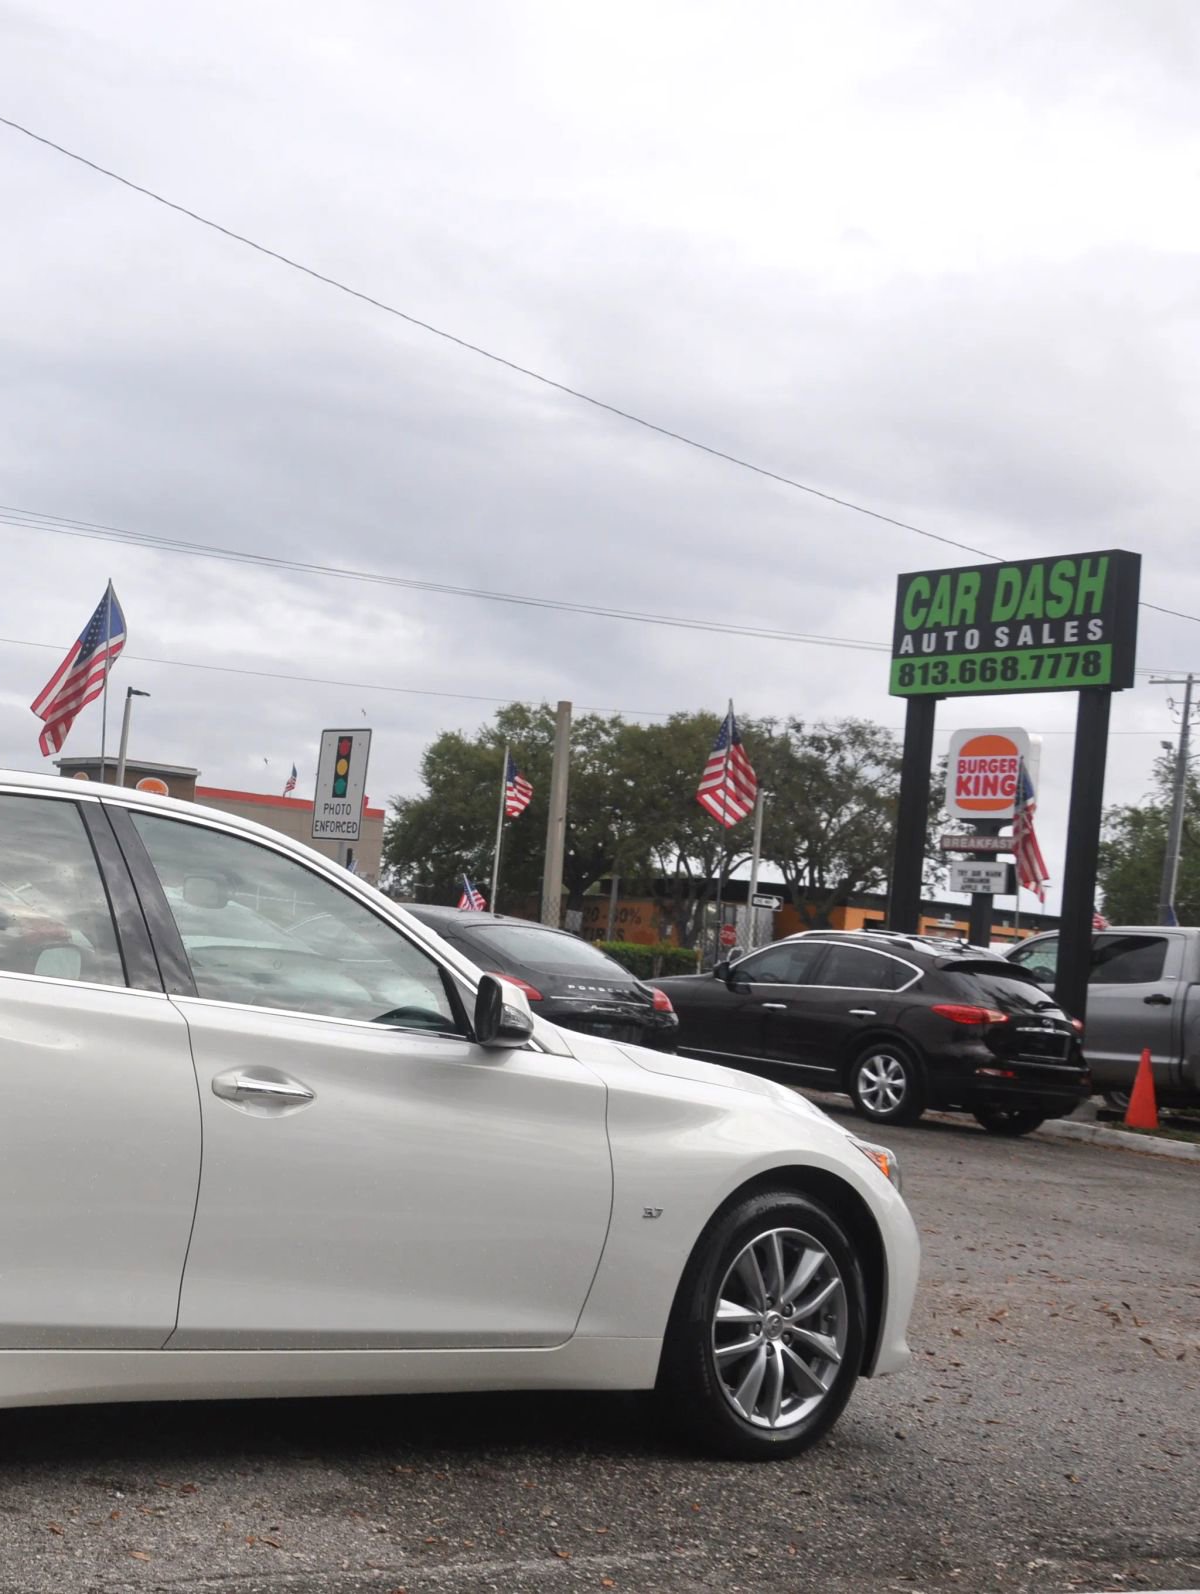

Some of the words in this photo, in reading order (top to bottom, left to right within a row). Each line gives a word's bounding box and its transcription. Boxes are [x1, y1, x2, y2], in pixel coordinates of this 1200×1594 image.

[902, 571, 981, 631] CAR
[991, 557, 1109, 623] DASH
[900, 628, 981, 655] AUTO
[994, 618, 1104, 648] SALES
[897, 650, 1103, 688] 813.668.7778
[956, 758, 1017, 775] BURGER
[955, 774, 1017, 798] KING
[323, 802, 352, 816] PHOTO
[314, 819, 358, 834] ENFORCED
[943, 837, 1013, 849] BREAKFAST
